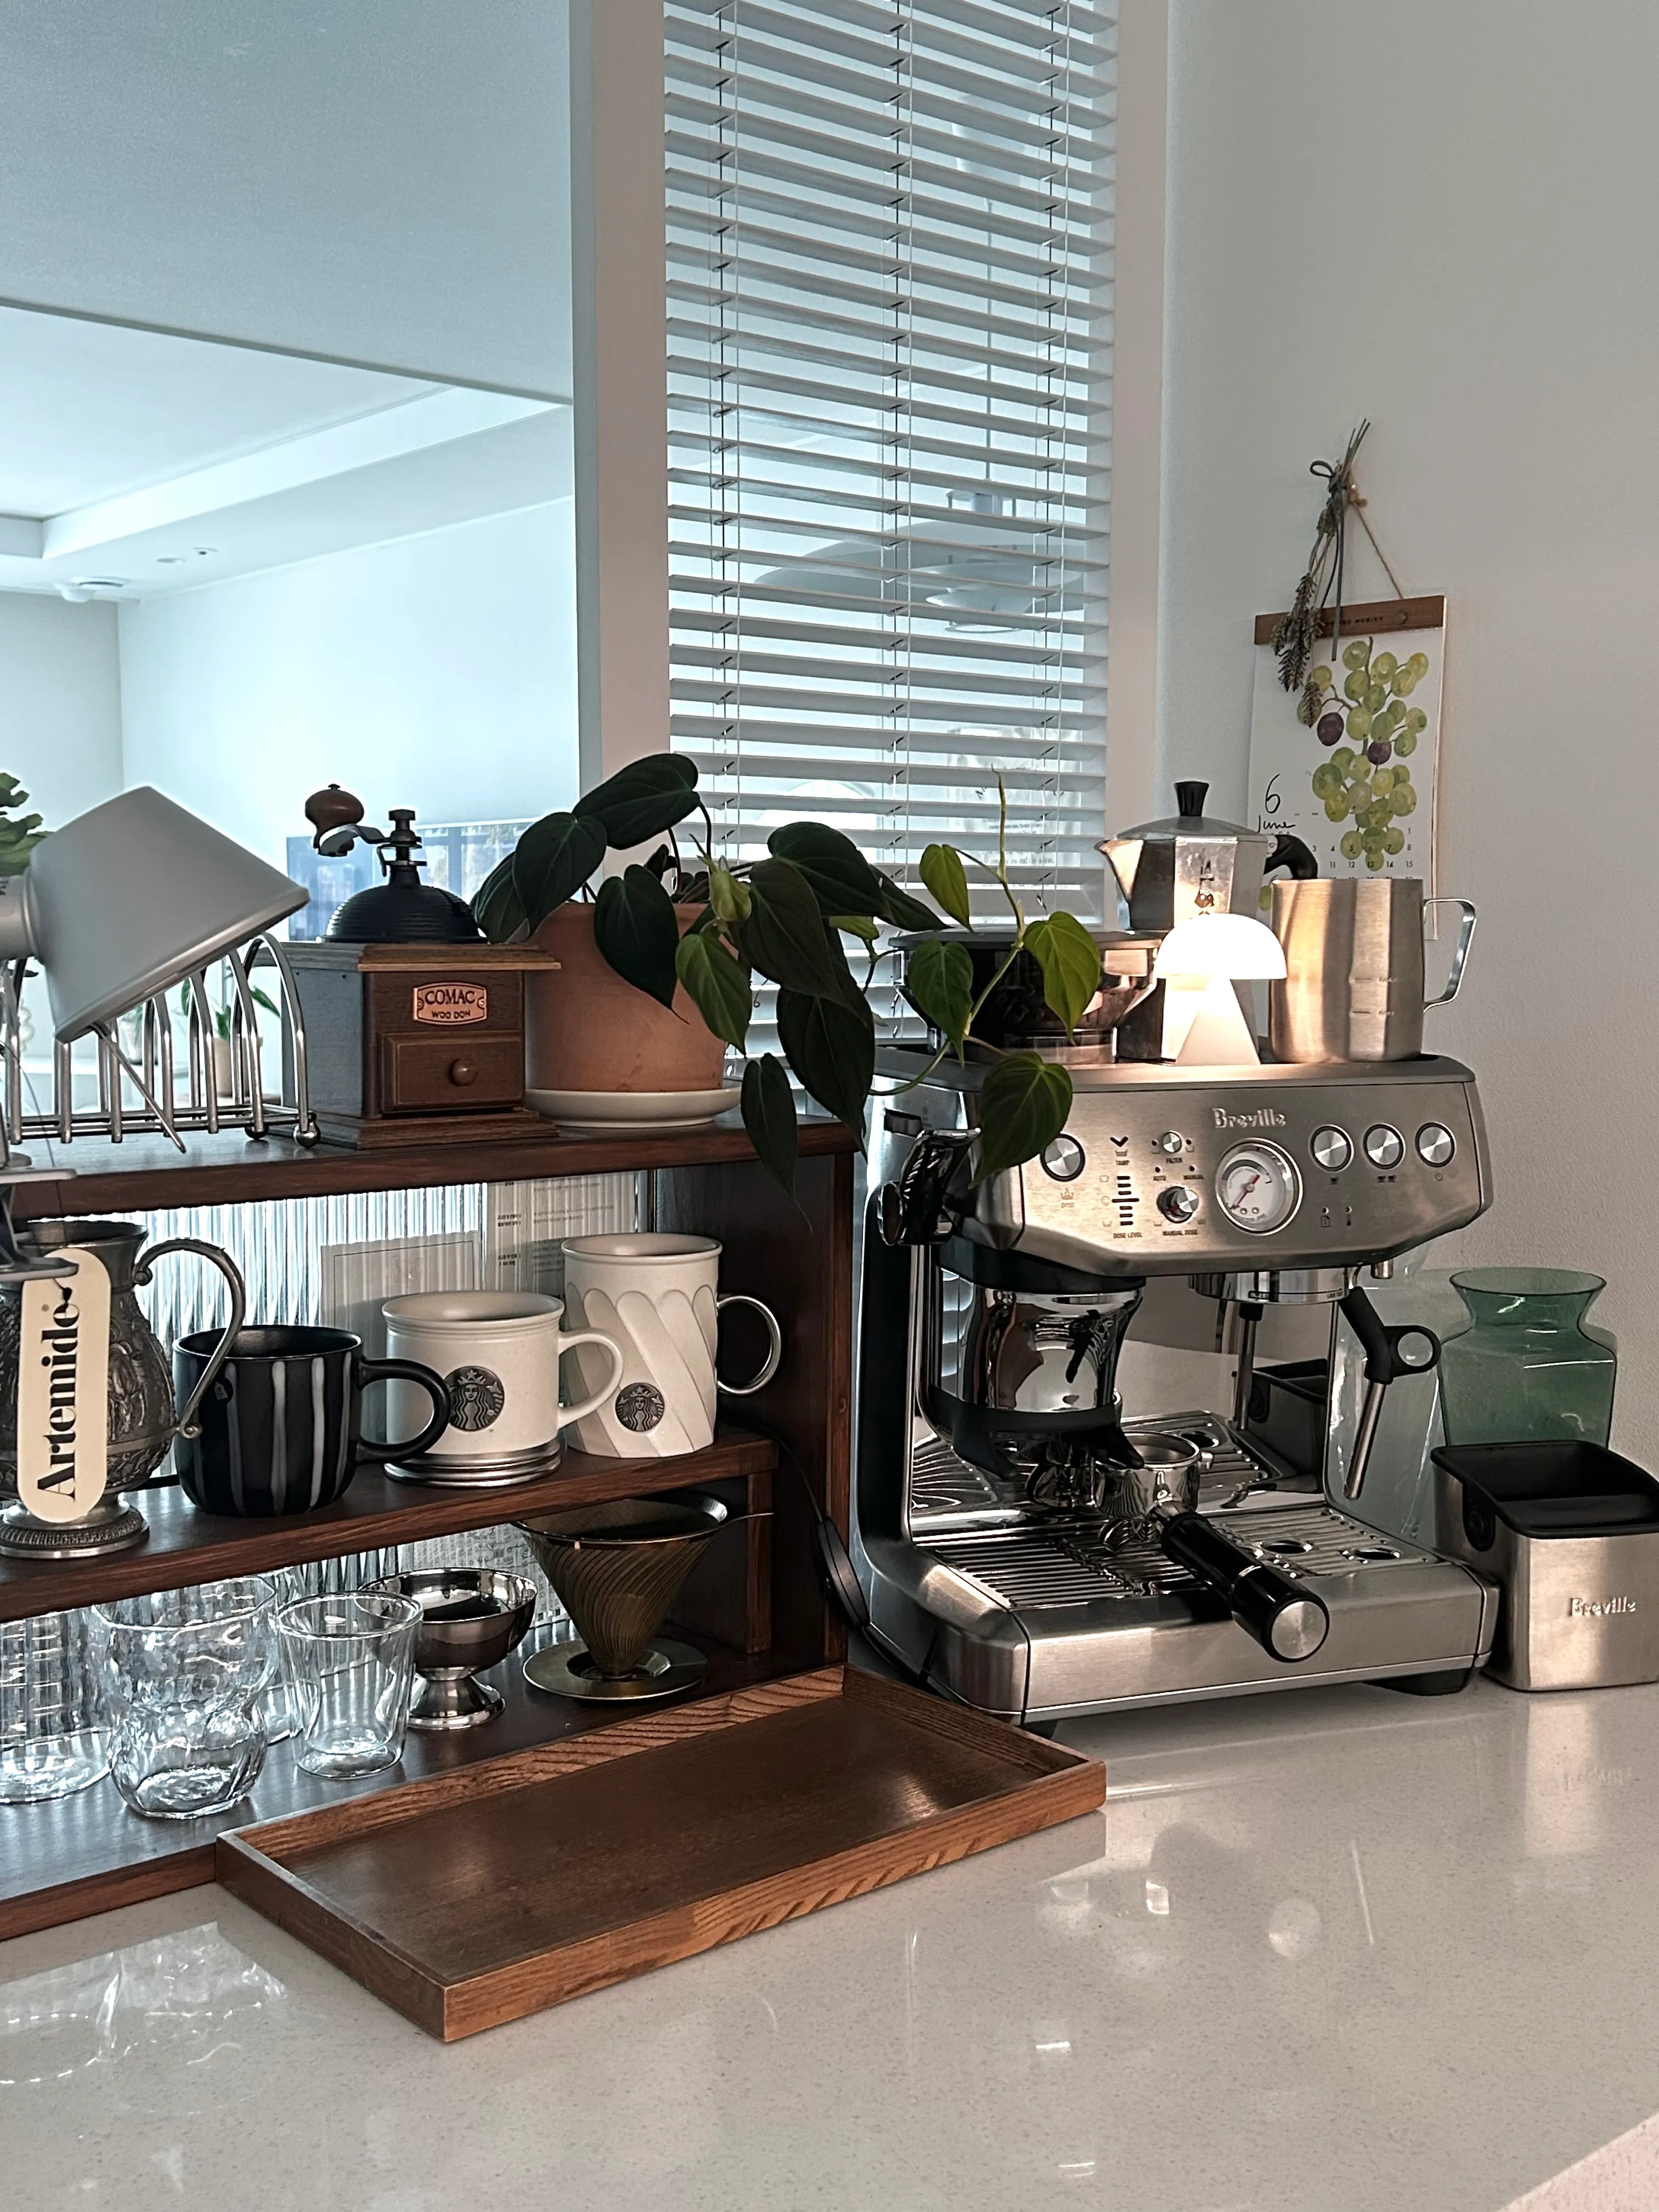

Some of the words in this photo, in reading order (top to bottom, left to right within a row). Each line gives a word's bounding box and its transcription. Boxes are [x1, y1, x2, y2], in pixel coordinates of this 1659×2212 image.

[1265, 774, 1281, 814] 6
[1257, 814, 1296, 833] June
[425, 989, 475, 1006] COMAC
[1212, 1108, 1286, 1128] Breville
[37, 1302, 80, 1501] Artemide
[1568, 1596, 1636, 1617] Breville
